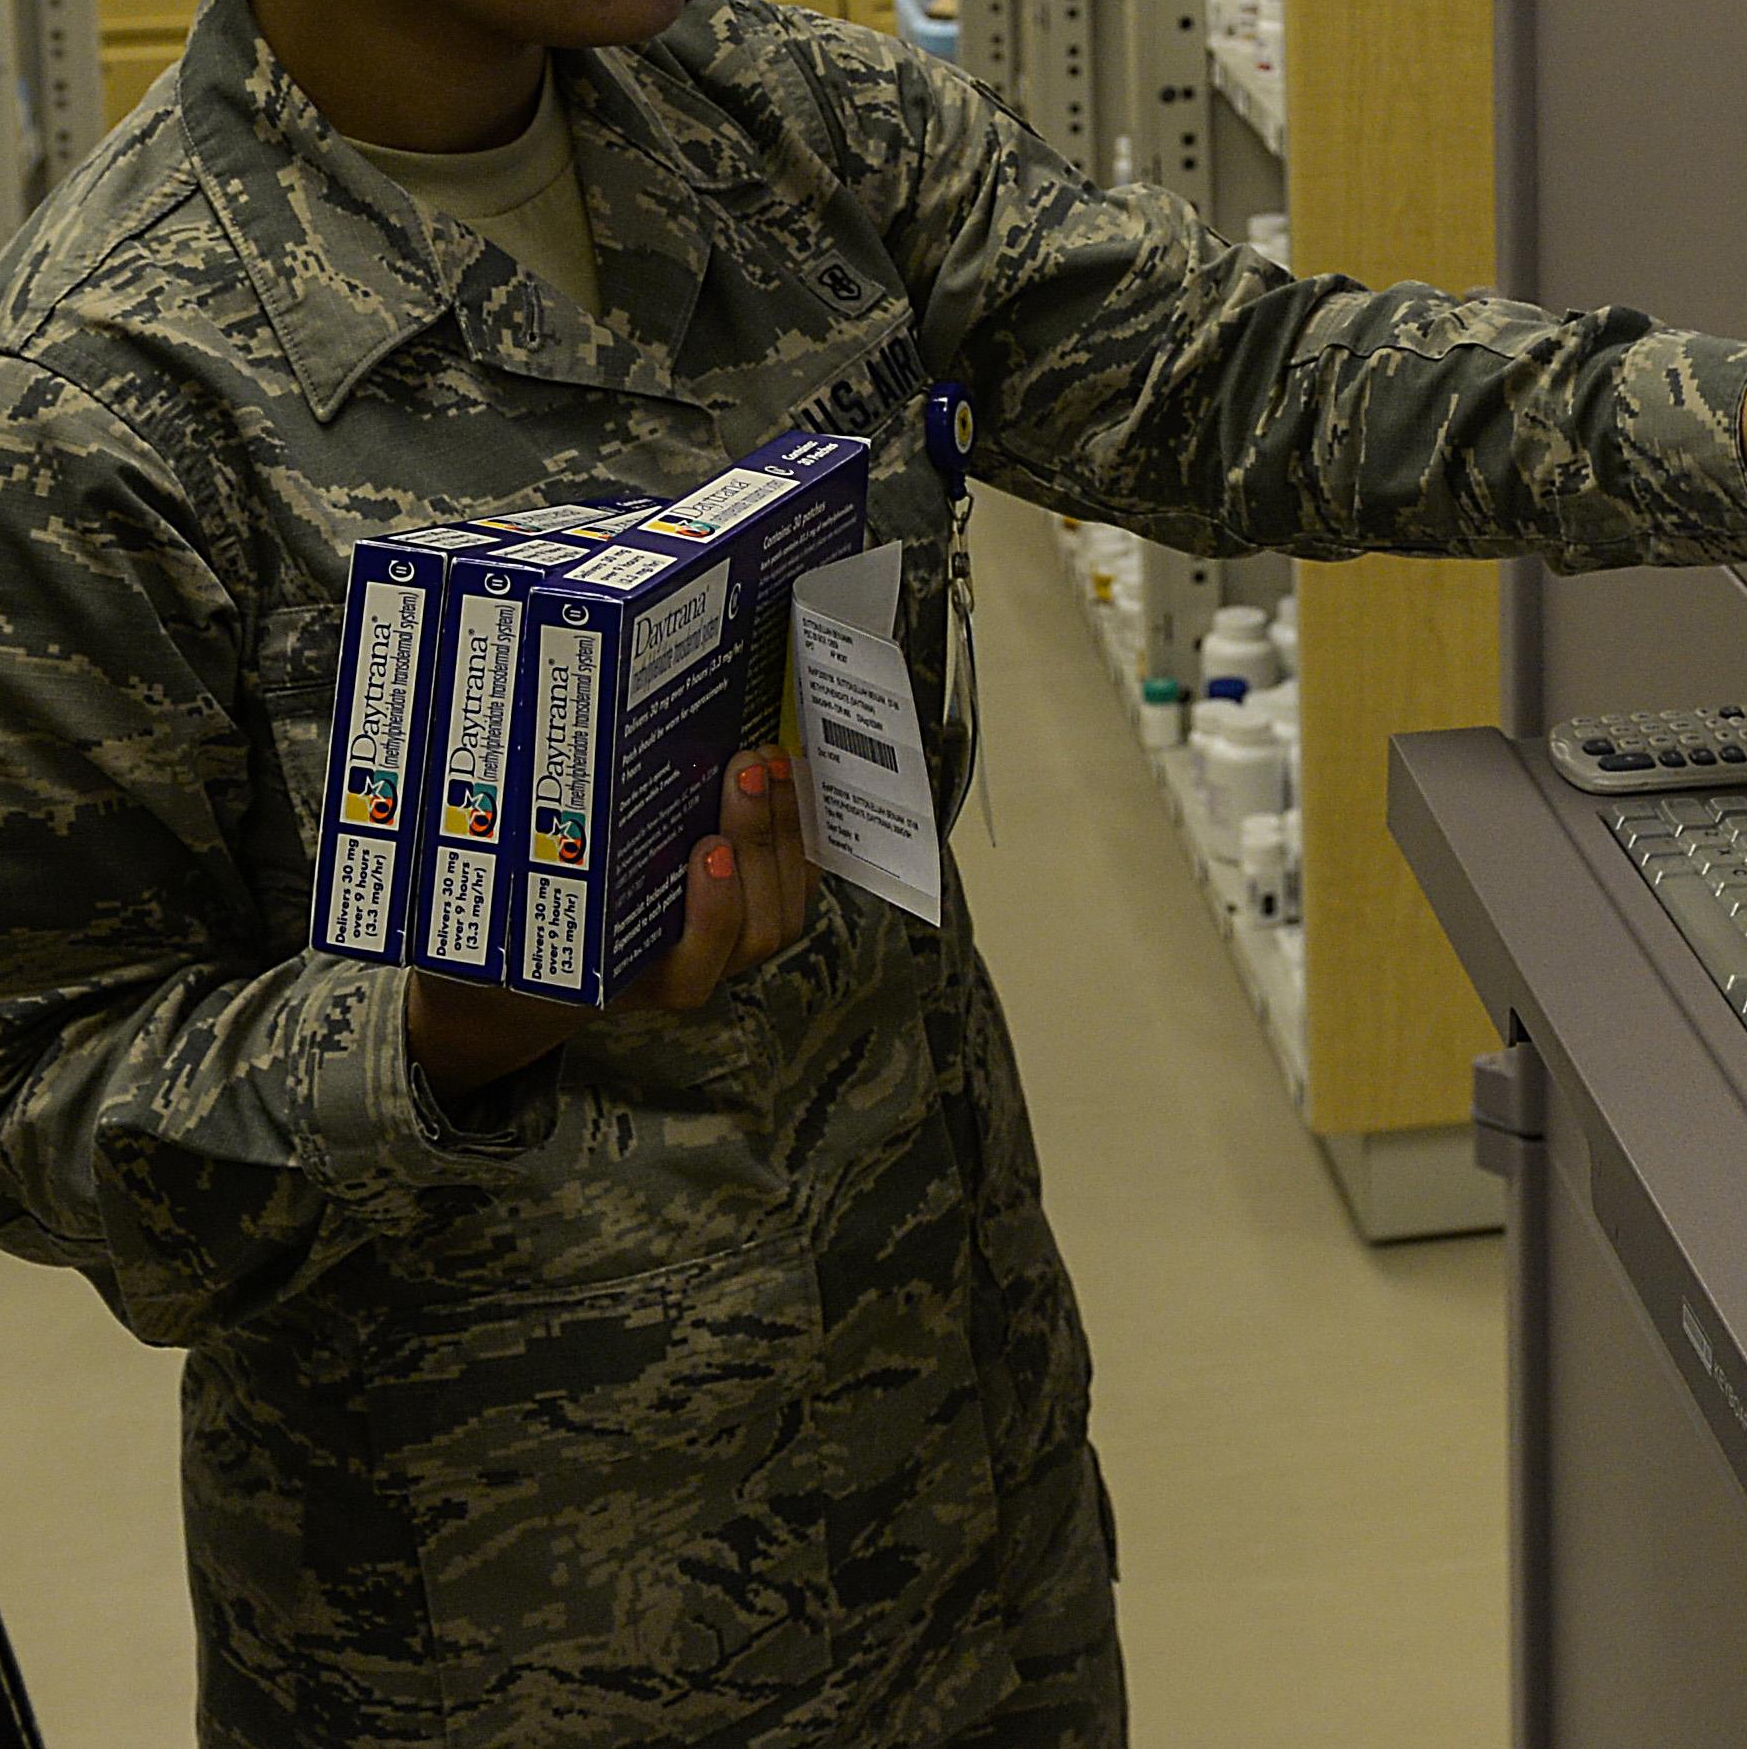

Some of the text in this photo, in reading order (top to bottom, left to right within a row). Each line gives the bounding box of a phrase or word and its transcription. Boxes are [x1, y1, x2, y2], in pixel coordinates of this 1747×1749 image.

[634, 590, 707, 659] Daytrana
[336, 837, 360, 945] Delivers 30 mg
[352, 848, 371, 940] over 9 hours
[365, 853, 387, 938] (3.3 mg/hr)
[435, 850, 460, 958] Delivers 30 mg
[453, 860, 471, 952] over 9 hours
[465, 866, 487, 951] (3.3 mg/hr)
[531, 876, 551, 981] Delivers 30 mg
[548, 886, 563, 977] over 9 hours
[560, 892, 579, 976] (3.3 mg/hr)
